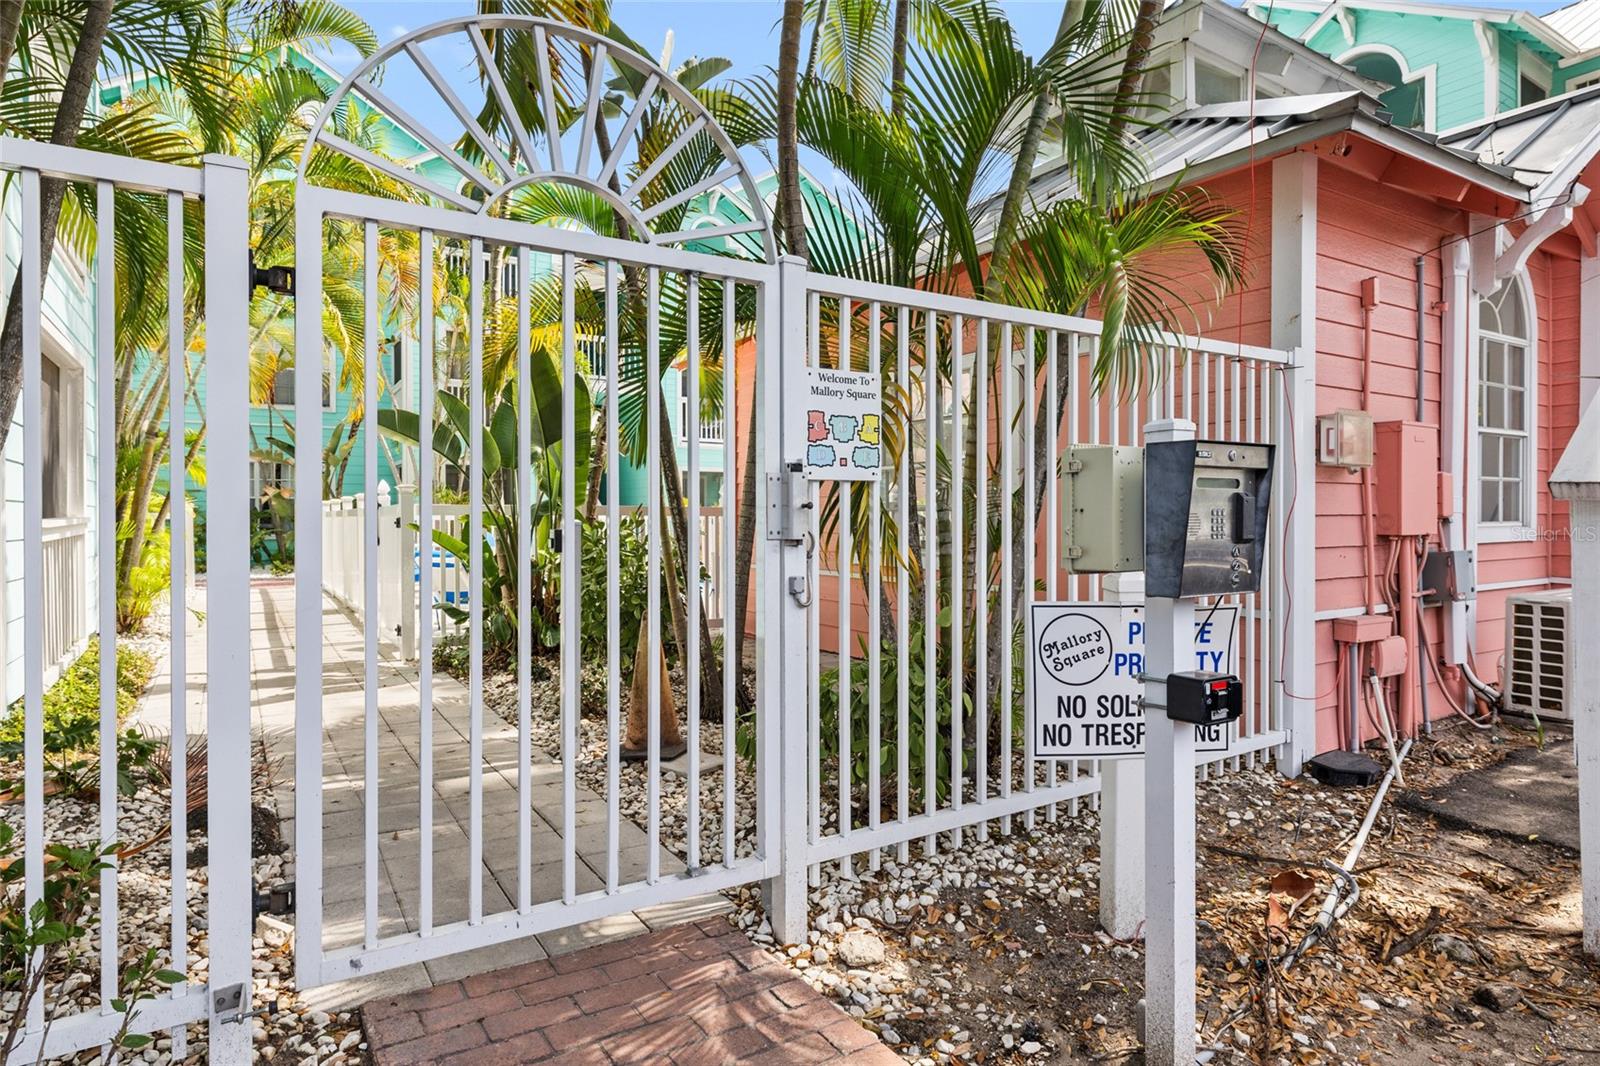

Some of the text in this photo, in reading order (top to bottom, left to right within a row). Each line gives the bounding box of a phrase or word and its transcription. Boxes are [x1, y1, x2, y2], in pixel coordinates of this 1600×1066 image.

[818, 372, 870, 386] Welcome To
[811, 386, 877, 400] Mallory Square
[1043, 629, 1103, 659] Mallory
[1052, 646, 1105, 672] Square
[1114, 651, 1224, 676] PRTY
[1057, 695, 1087, 718] NO
[1043, 722, 1220, 747] NO TRESPNG
